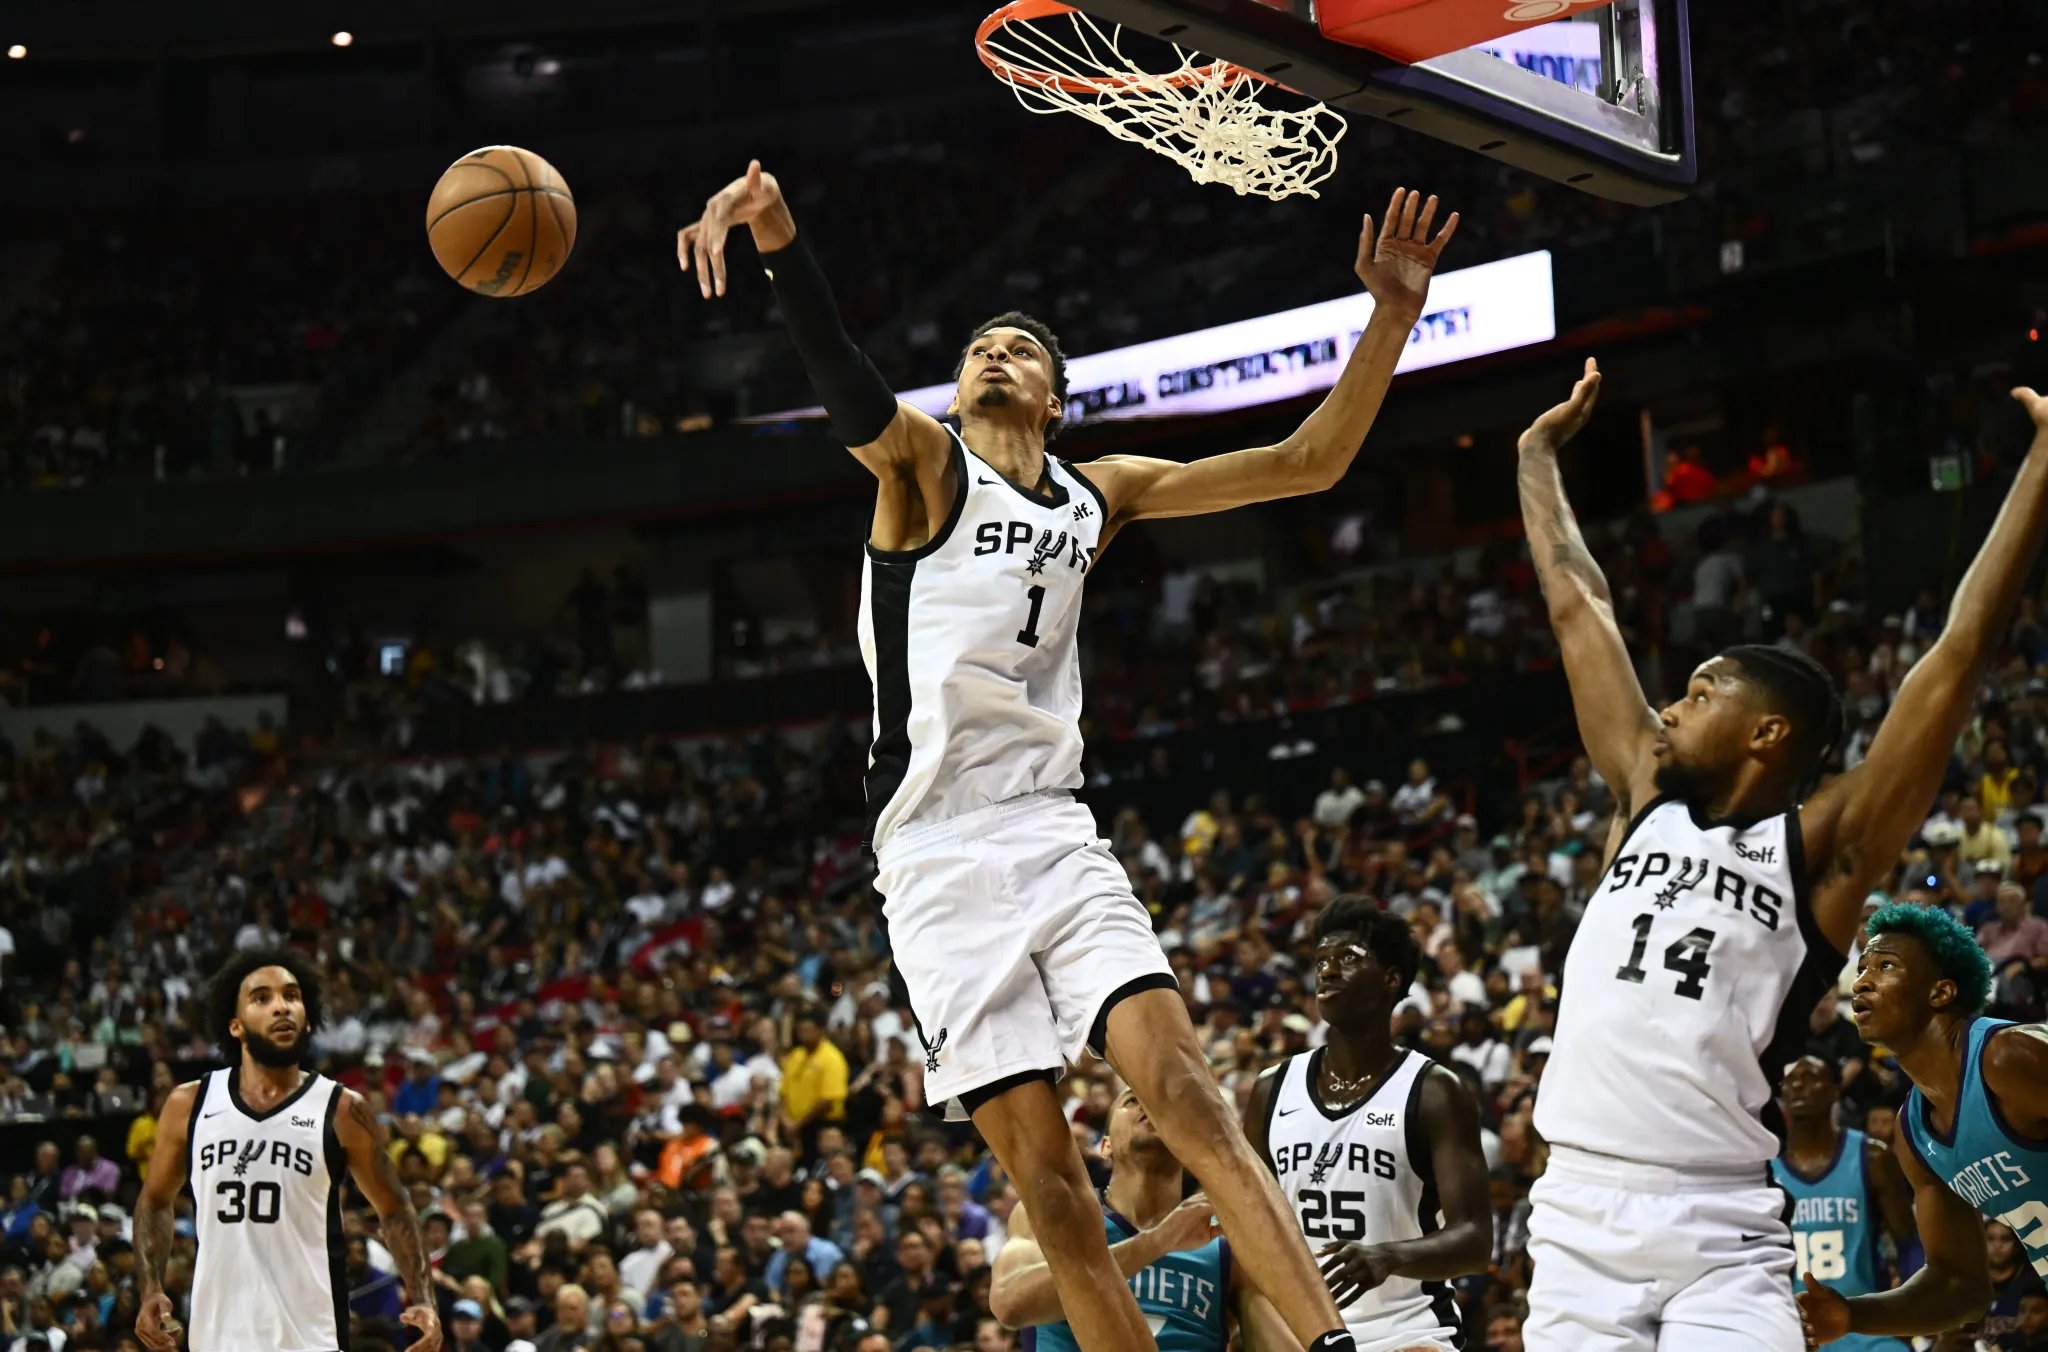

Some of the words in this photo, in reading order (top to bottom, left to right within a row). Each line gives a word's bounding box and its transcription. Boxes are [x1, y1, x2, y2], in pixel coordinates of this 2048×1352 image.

[1016, 584, 1046, 648] 1
[1735, 841, 1777, 865] Self.
[1609, 852, 1783, 932] SPURS
[1615, 912, 1717, 1001] 14
[291, 1115, 317, 1129] Self.
[1366, 1112, 1396, 1128] Self.
[200, 1139, 314, 1178] SPURS
[1276, 1142, 1397, 1184] SPURS
[216, 1180, 282, 1224] 30
[1298, 1188, 1366, 1241] 25
[1791, 1197, 1858, 1226] RNETS
[1793, 1229, 1846, 1281] 18
[1134, 1264, 1215, 1320] NETS
